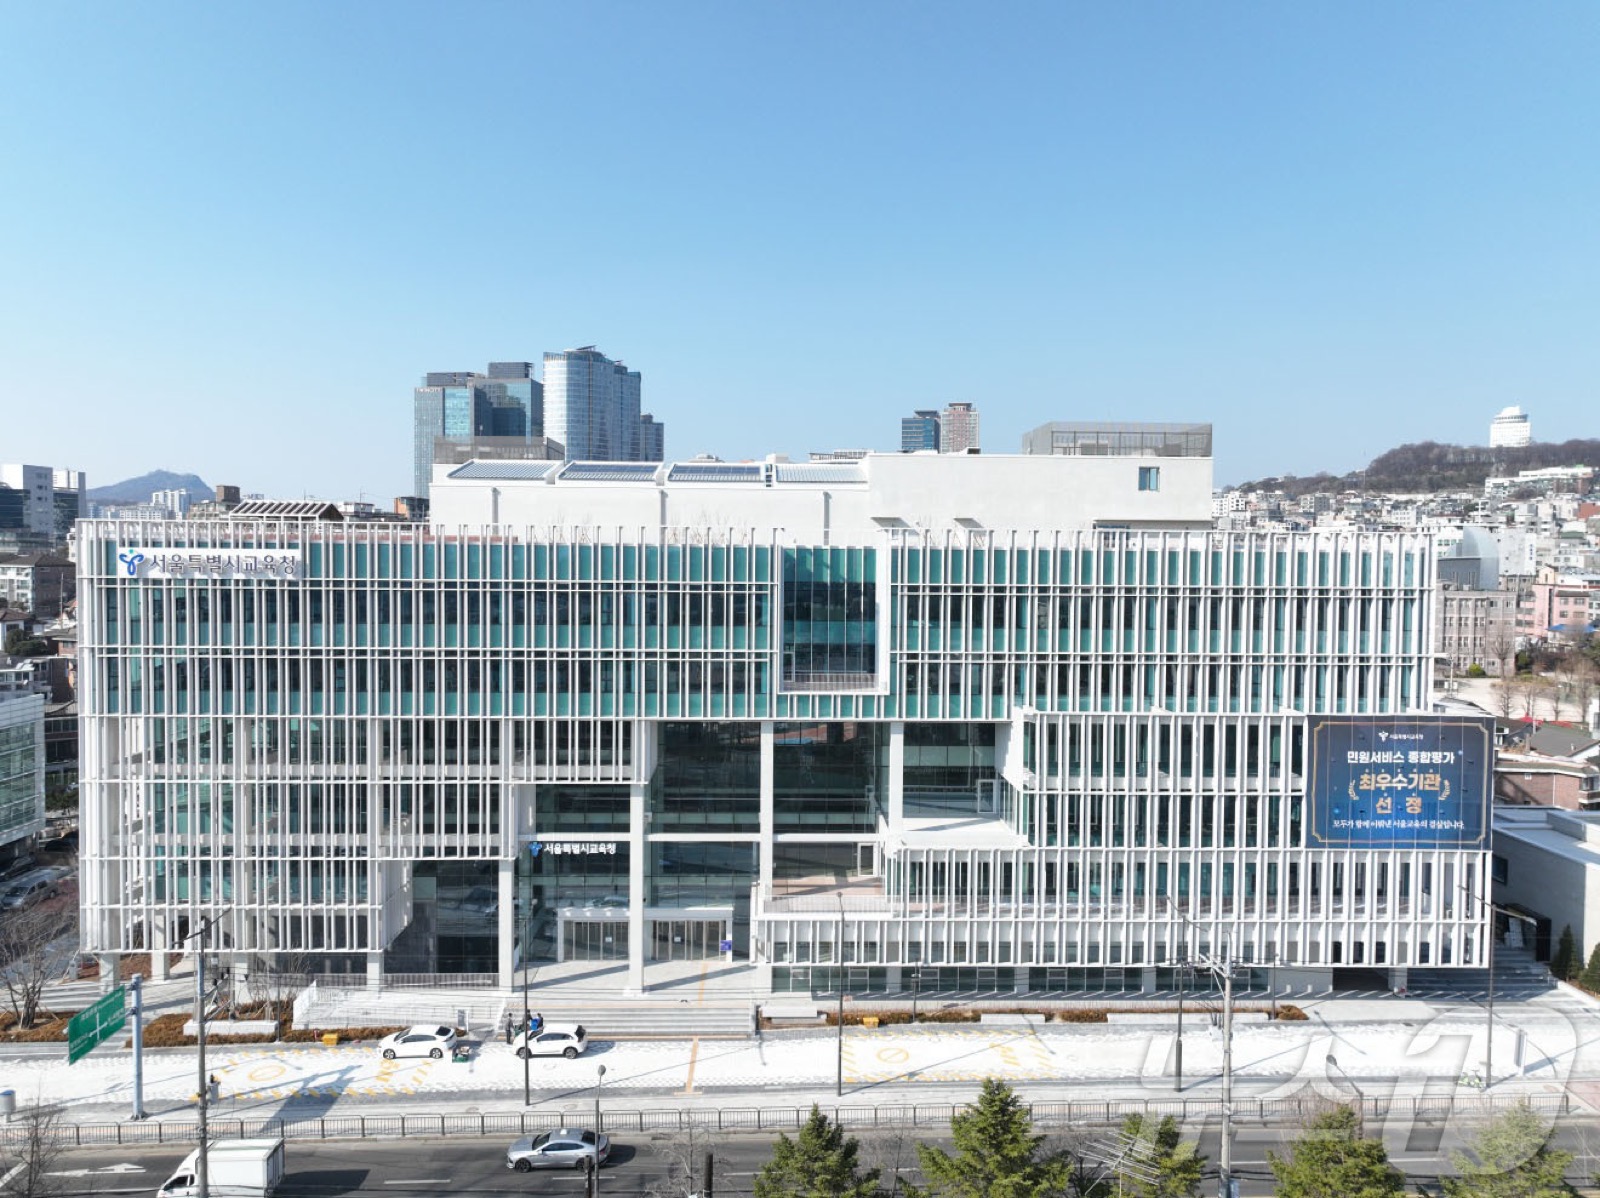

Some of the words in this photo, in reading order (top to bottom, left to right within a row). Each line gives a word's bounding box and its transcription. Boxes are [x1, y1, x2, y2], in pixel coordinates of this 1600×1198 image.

[150, 554, 295, 575] 서울특별시교육청
[1347, 750, 1405, 764] 민원서비스
[1407, 750, 1455, 765] 종합평가
[1359, 773, 1441, 791] 최우수기관
[1333, 819, 1354, 829] 모두가
[543, 842, 617, 855] 서울특별시교육청
